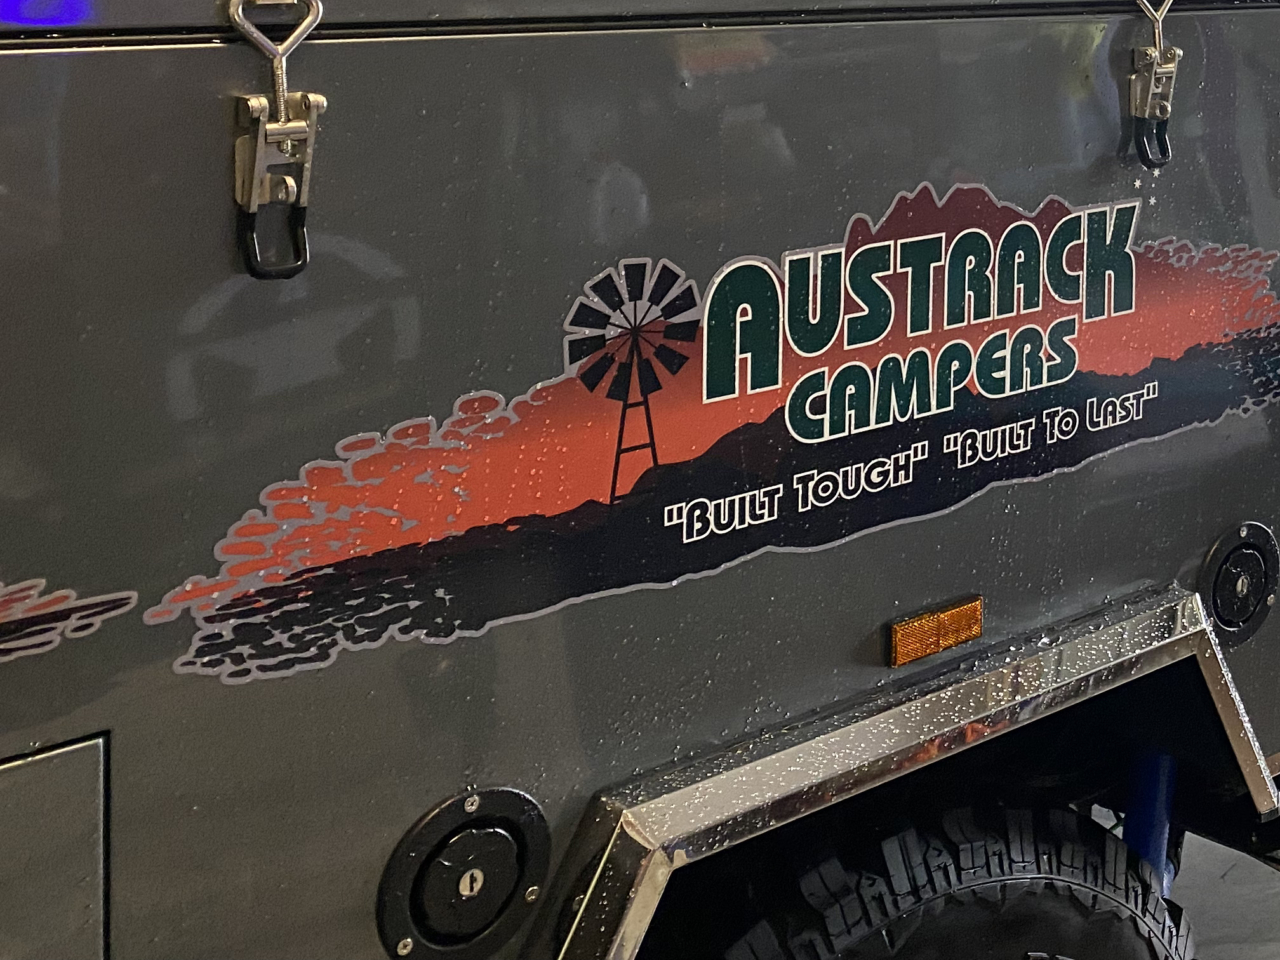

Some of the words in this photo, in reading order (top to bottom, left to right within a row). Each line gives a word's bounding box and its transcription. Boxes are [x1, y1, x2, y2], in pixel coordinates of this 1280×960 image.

[702, 199, 1141, 404] AUSTRACK
[785, 316, 1078, 444] CAMPERS
[1043, 406, 1079, 444] TO
